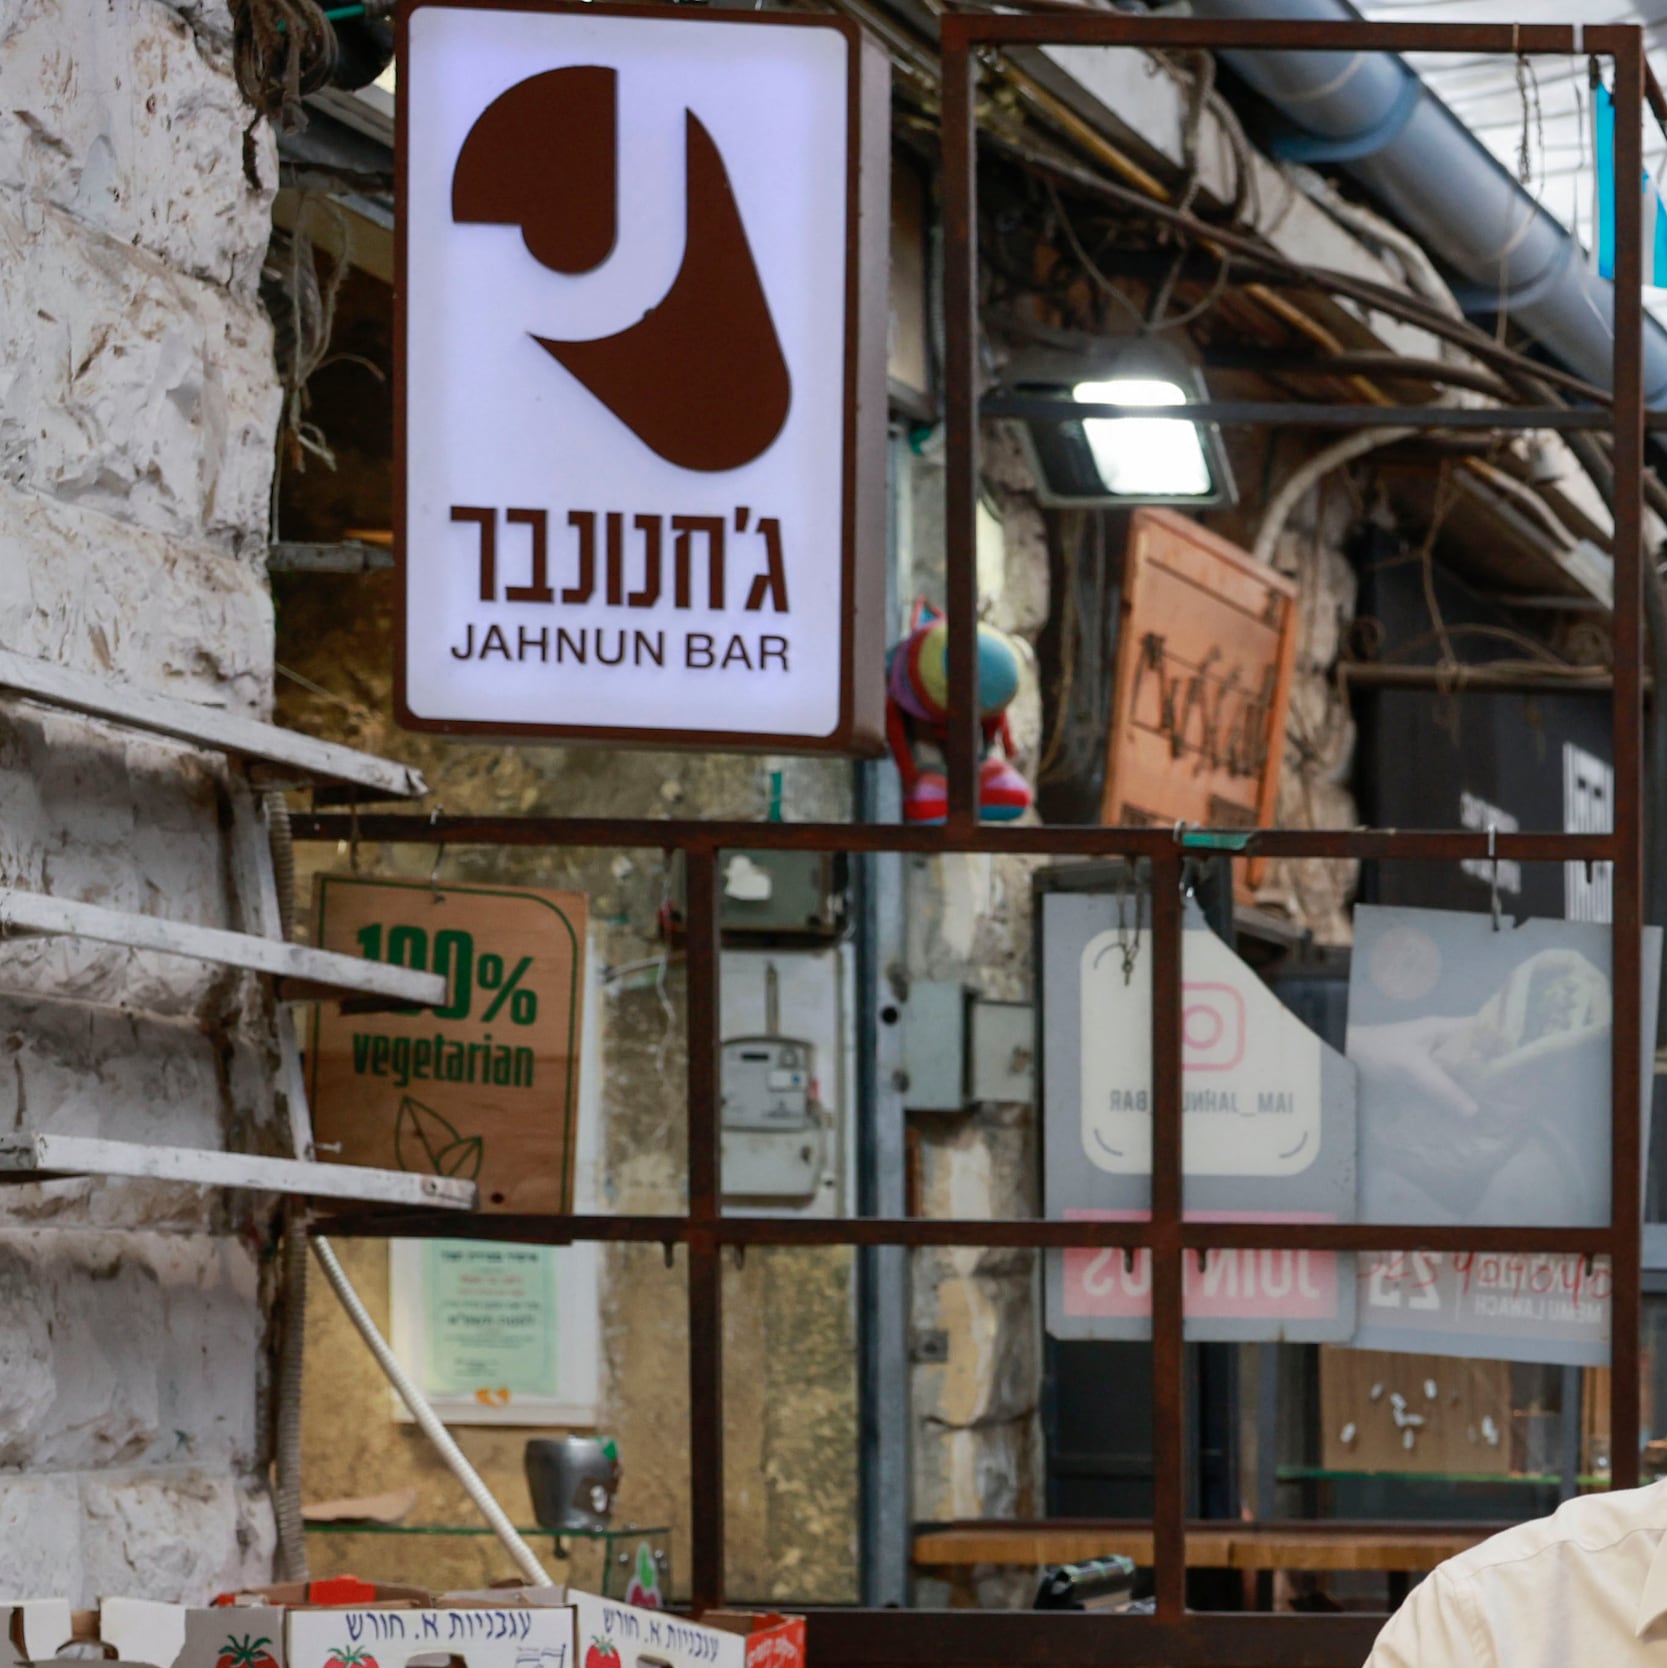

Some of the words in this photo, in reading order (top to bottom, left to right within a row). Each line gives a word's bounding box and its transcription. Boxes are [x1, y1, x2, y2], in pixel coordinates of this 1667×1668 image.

[450, 505, 789, 613] ג'חנונבר
[451, 623, 664, 667] JAHNUN
[686, 633, 789, 672] BAR
[353, 1033, 534, 1088] vegetarian
[346, 1612, 405, 1642] חורש
[449, 1611, 533, 1640] עגבניות
